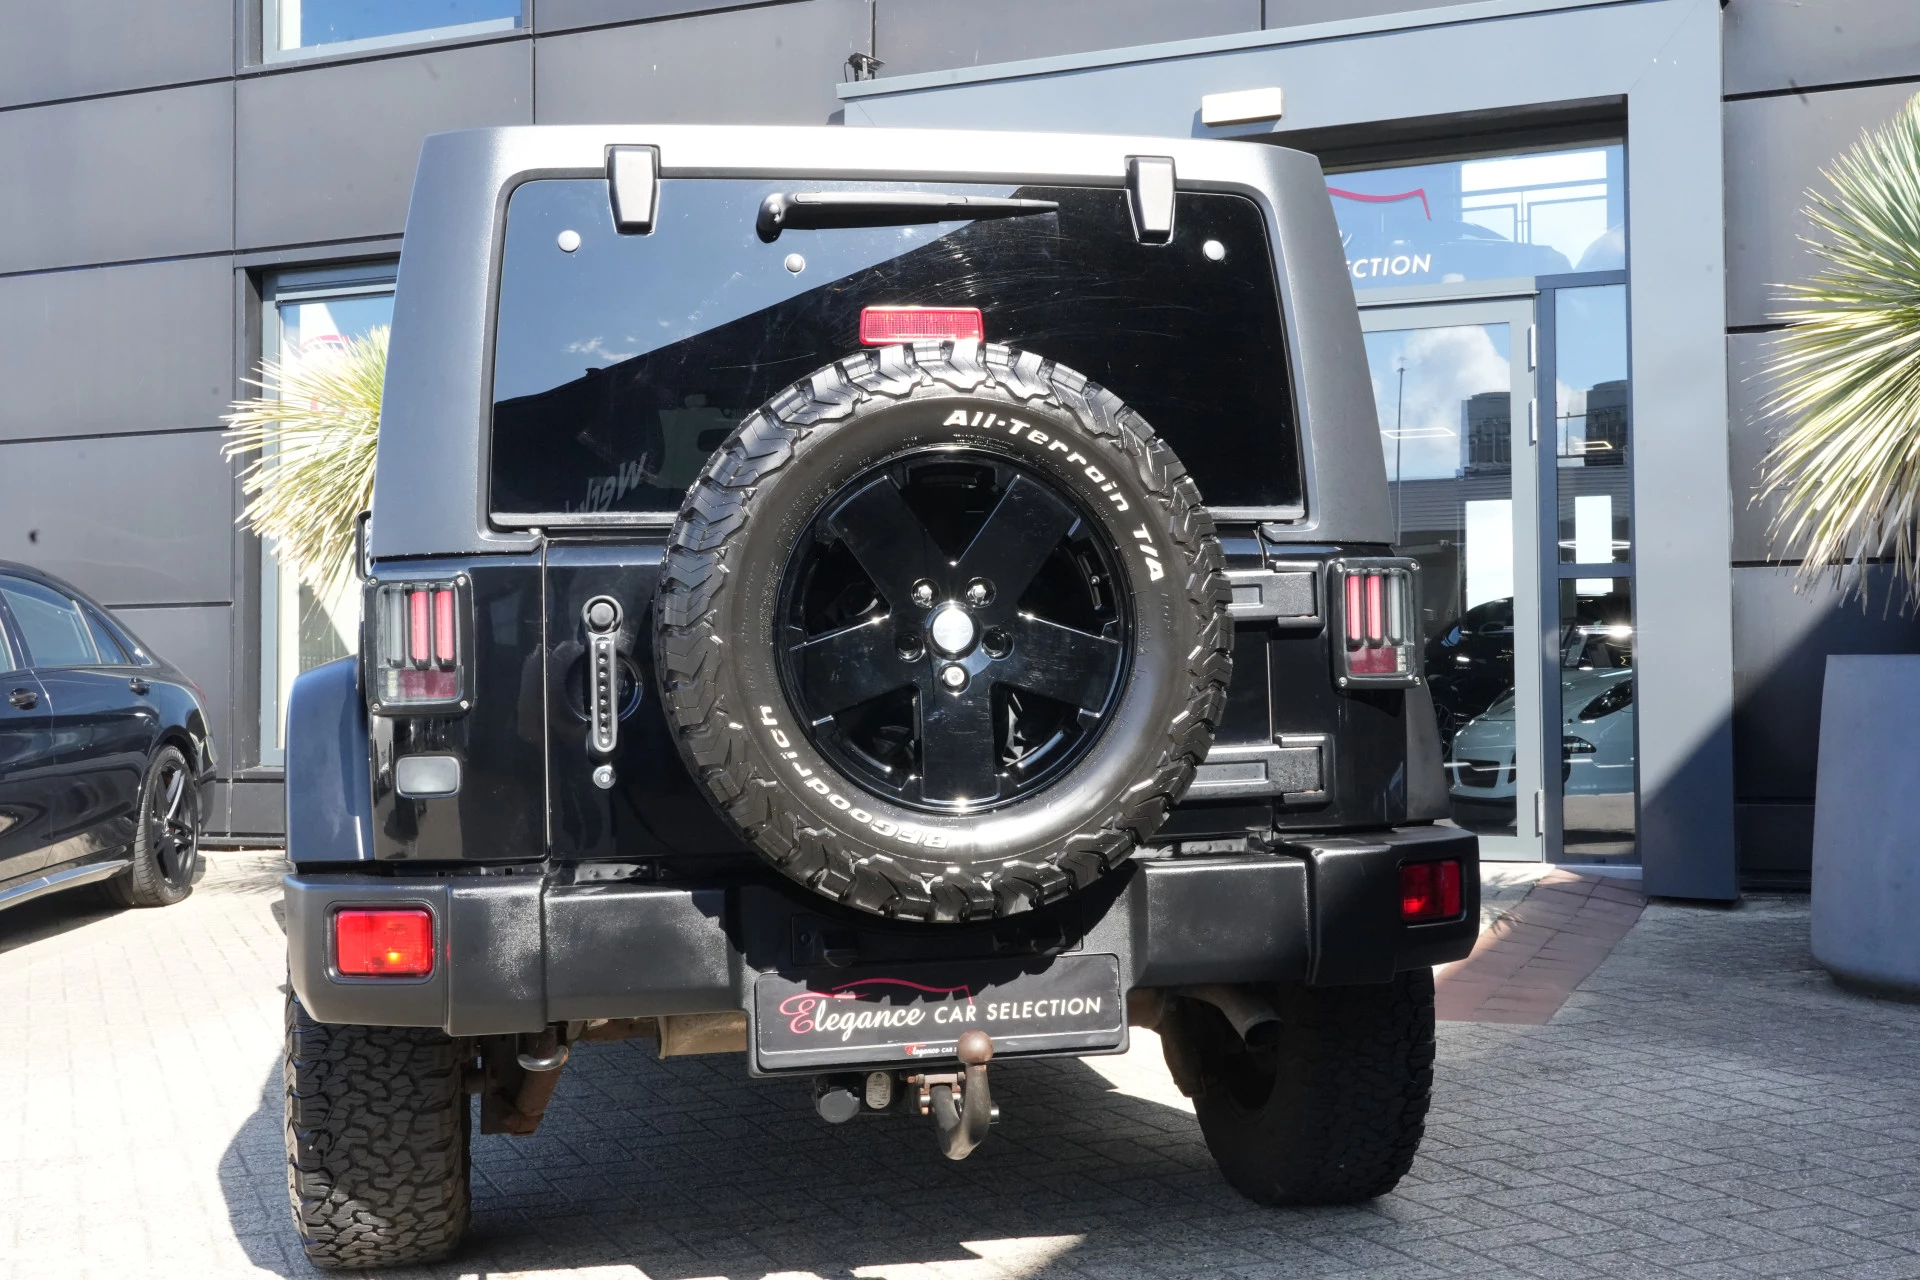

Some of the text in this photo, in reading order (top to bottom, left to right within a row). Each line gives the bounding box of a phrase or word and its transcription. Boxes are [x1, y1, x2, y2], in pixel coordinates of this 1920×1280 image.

[943, 410, 1129, 512] All-Terrain
[1132, 523, 1165, 582] T/A
[760, 705, 949, 849] BFGoodrich
[779, 992, 1102, 1041] Elegance CAR SELECTION
